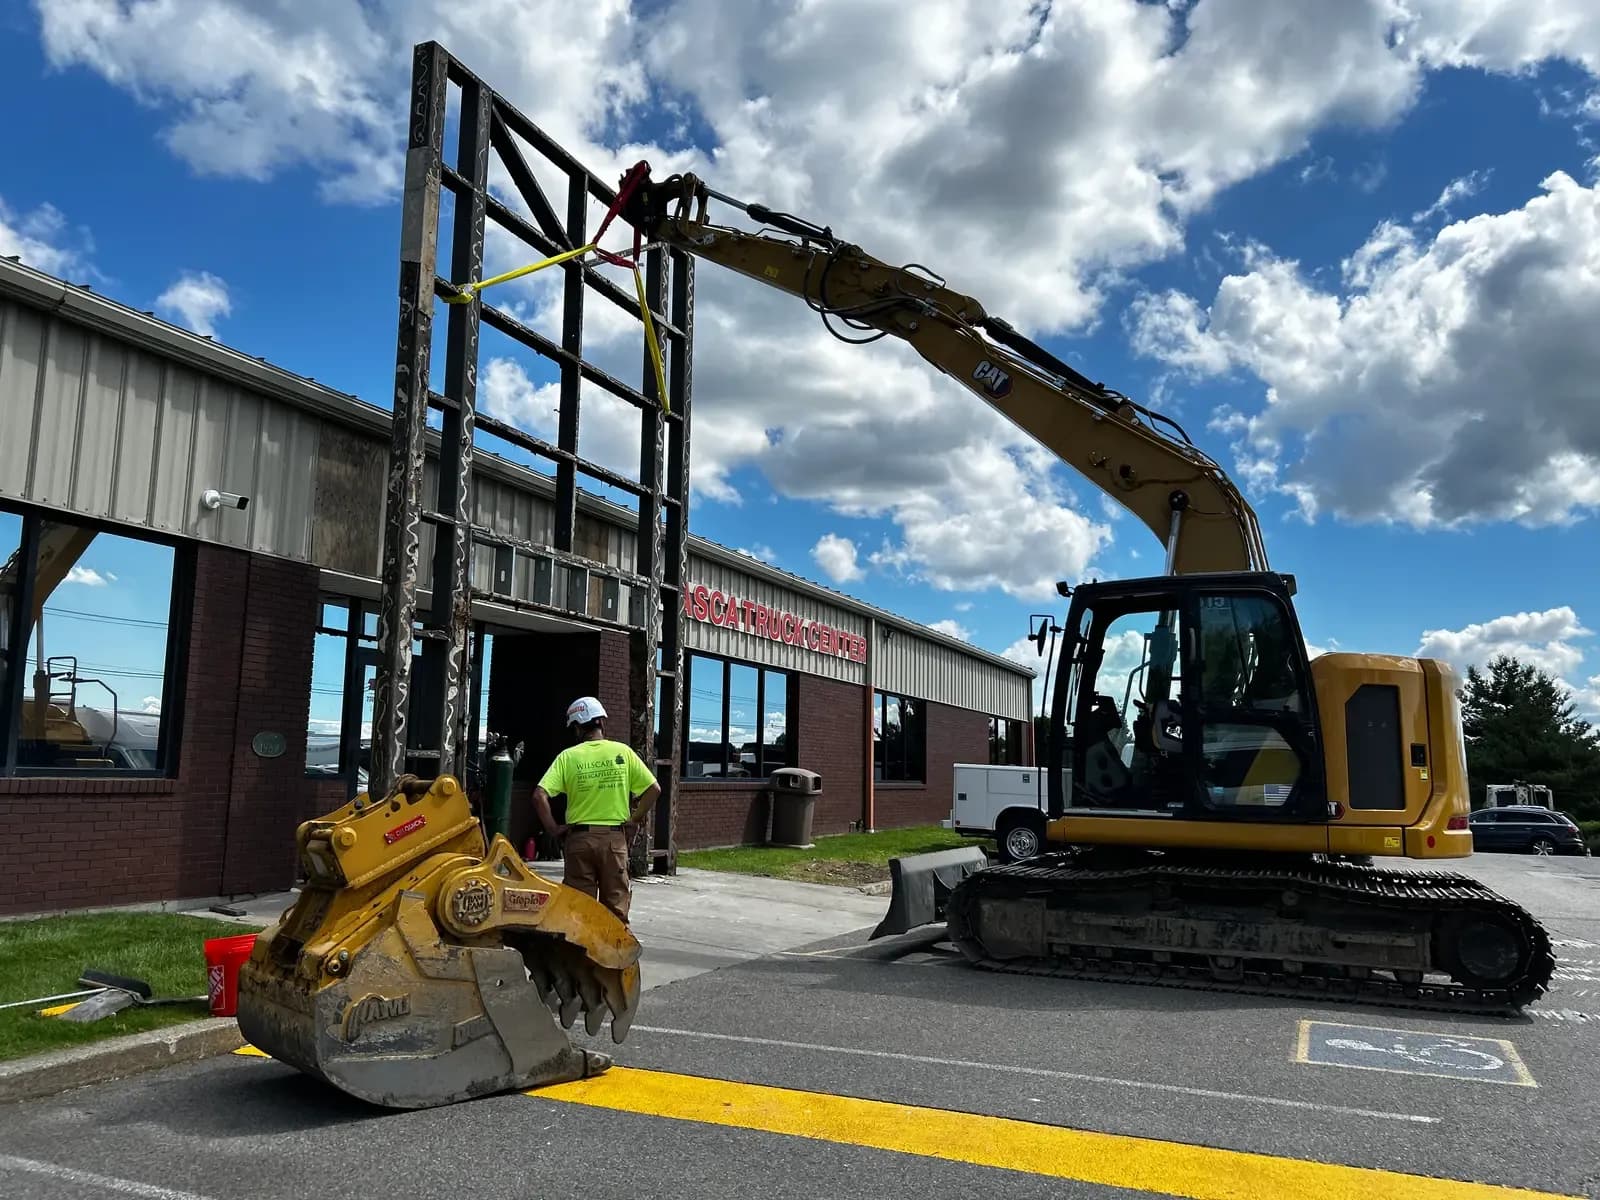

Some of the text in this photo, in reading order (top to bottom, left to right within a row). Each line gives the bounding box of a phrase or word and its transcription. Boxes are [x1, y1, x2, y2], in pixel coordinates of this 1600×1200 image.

[972, 360, 1009, 392] CAT
[741, 600, 804, 646] TRUCK
[807, 621, 867, 665] CENTER
